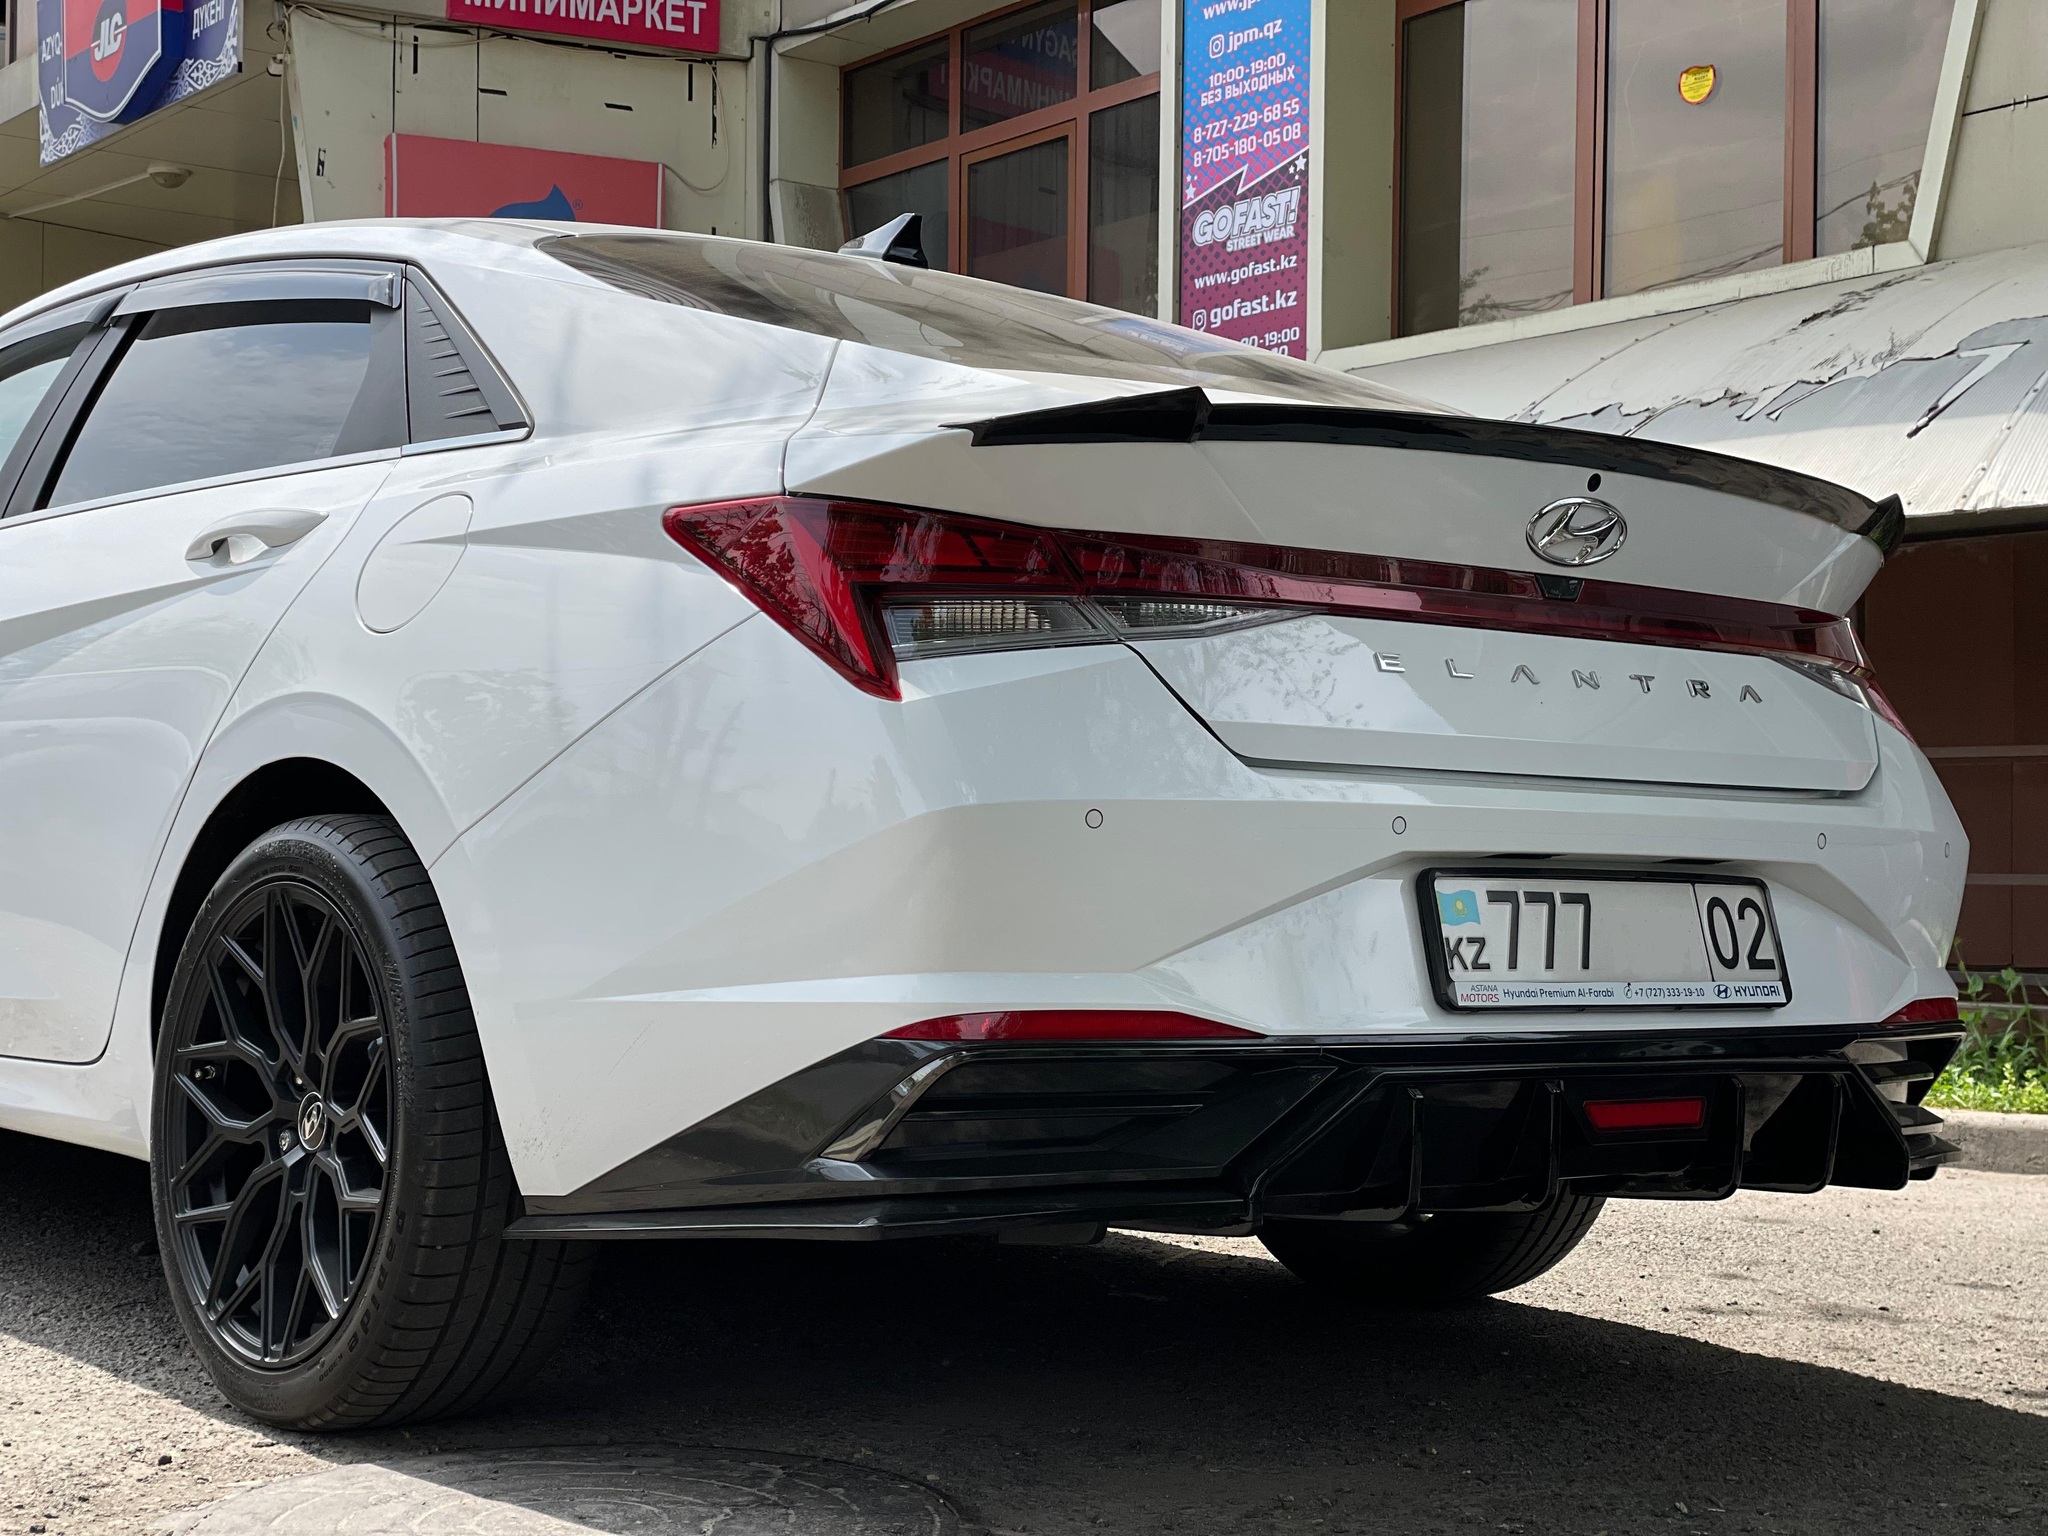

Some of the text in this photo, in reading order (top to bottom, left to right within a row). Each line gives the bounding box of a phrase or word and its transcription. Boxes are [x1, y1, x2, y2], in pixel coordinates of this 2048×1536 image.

[1226, 19, 1283, 53] jpm.qz
[1201, 65, 1295, 107] БЕЗ ВЫХОДНЫХ
[1208, 52, 1286, 88] 10:00-19:00
[1193, 98, 1300, 144] 8-727-229-68 55
[1193, 122, 1301, 168] 8-705-180-05 08
[1192, 185, 1301, 246] GOFAST!
[1226, 225, 1295, 253] STREET WEAR
[1194, 254, 1298, 289] www.gofast.kz
[1210, 289, 1297, 328] gofast.kz
[1373, 652, 1763, 704] ELANTRA
[1486, 890, 1776, 970] 777 02
[1445, 936, 1491, 970] KZ
[1460, 993, 1500, 1003] MOTORS
[1470, 984, 1498, 992] ASTANA
[1503, 987, 1615, 1000] Hyundai Premium Al-Farabi
[1634, 987, 1705, 999] +7 (727) 333-19-10
[1733, 985, 1781, 997] HYUNDAI
